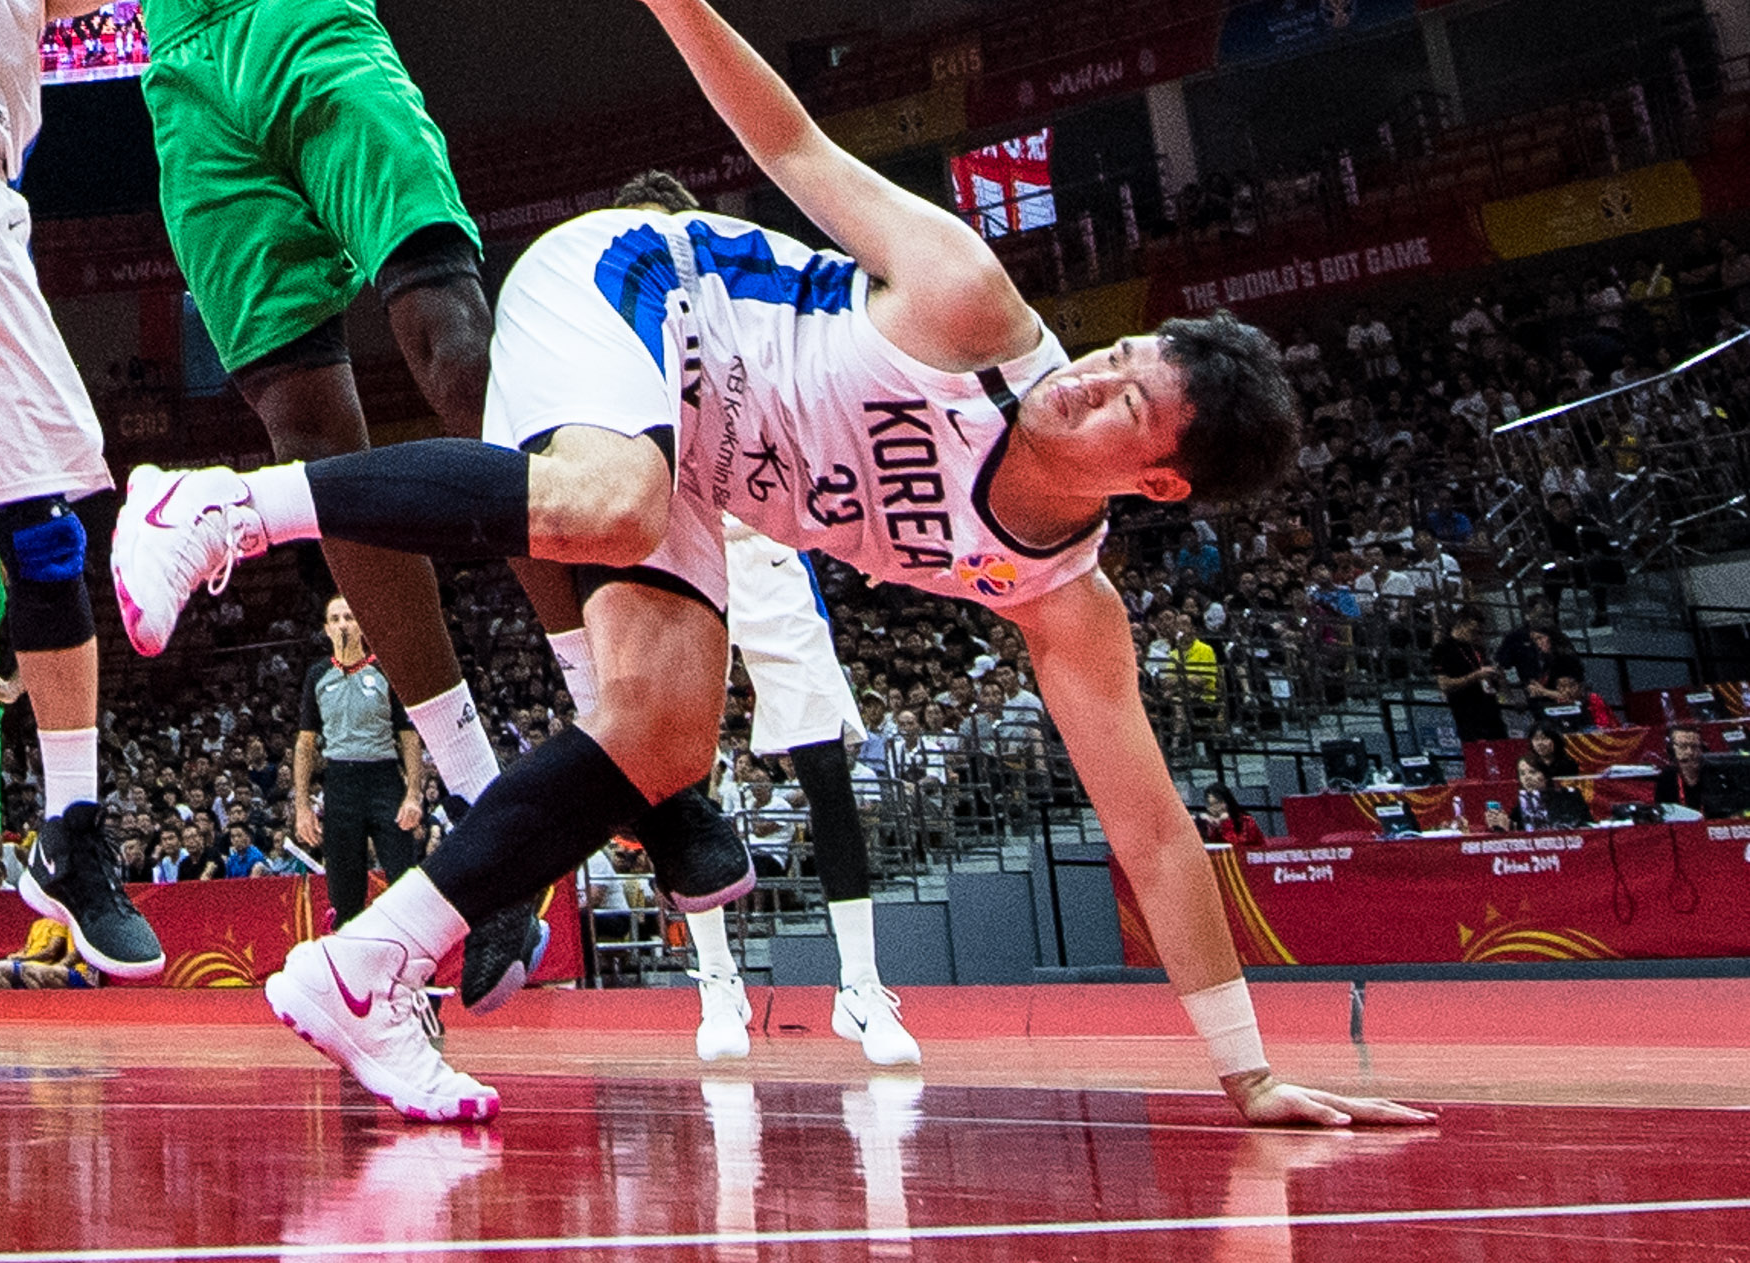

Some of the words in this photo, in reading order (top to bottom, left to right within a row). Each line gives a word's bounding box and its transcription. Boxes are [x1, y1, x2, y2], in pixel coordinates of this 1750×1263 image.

[1180, 284, 1220, 311] THE
[1220, 257, 1317, 303] WORLD'S
[1319, 252, 1364, 283] GOT
[1366, 236, 1432, 276] GAME
[724, 355, 748, 395] KB
[863, 399, 954, 569] KOREA
[1264, 848, 1311, 864] BASKETBALL
[1481, 838, 1535, 854] BASKETBALL
[1273, 866, 1307, 884] China
[1308, 864, 1334, 881] 2019
[1492, 856, 1530, 876] China
[1530, 854, 1561, 874] 2019
